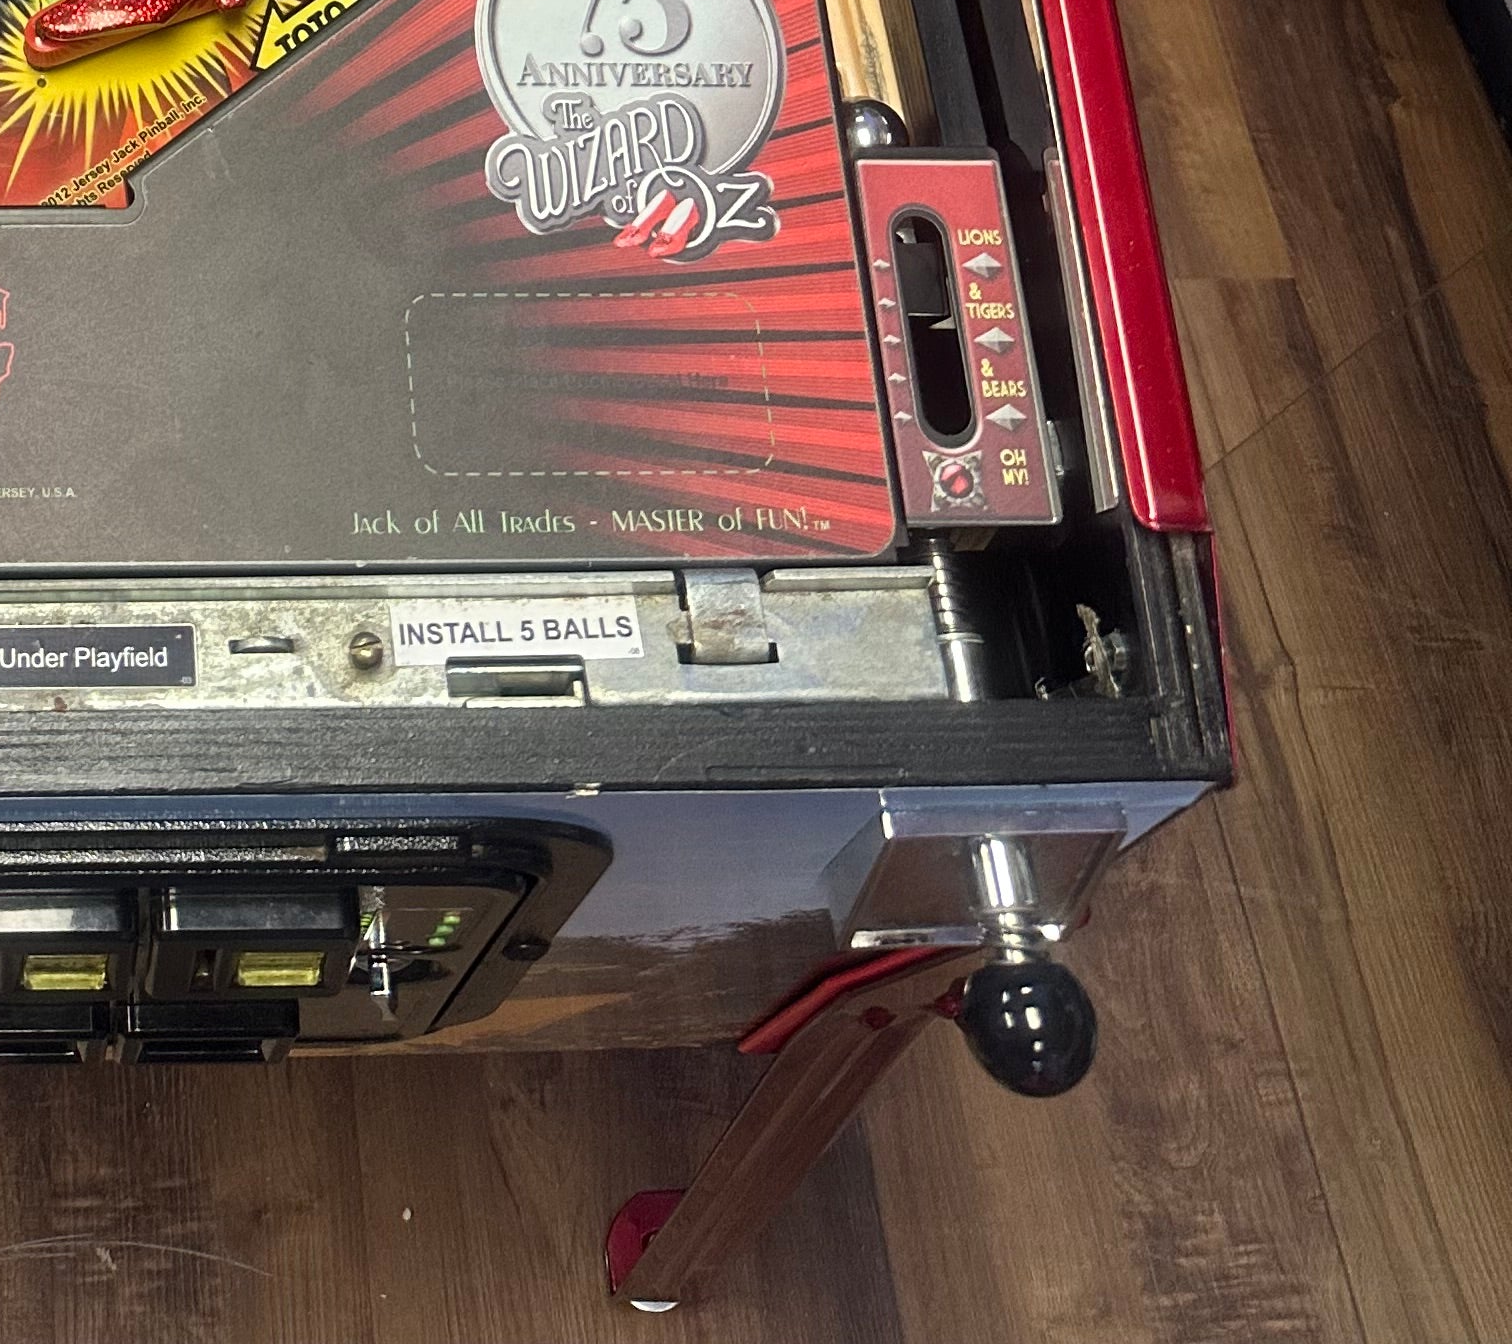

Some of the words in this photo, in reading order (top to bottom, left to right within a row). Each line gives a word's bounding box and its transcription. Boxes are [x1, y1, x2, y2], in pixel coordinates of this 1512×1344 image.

[551, 99, 593, 129] The
[72, 160, 111, 192] Jersey
[112, 141, 139, 162] Jack
[139, 110, 184, 143] Pinball,
[182, 96, 207, 114] Inc.
[612, 178, 637, 213] of
[958, 230, 1002, 245] LIONS
[969, 282, 981, 300] &
[966, 302, 1015, 319] TIGERS
[981, 359, 993, 377] &
[981, 381, 1027, 398] BEARS
[1000, 449, 1027, 467] OH
[1002, 469, 1030, 486] MY!
[612, 508, 703, 532] MASTER
[399, 620, 512, 646] INSTALL
[520, 620, 535, 642] 5
[543, 616, 633, 642] BALLS
[73, 645, 168, 672] Playfield
